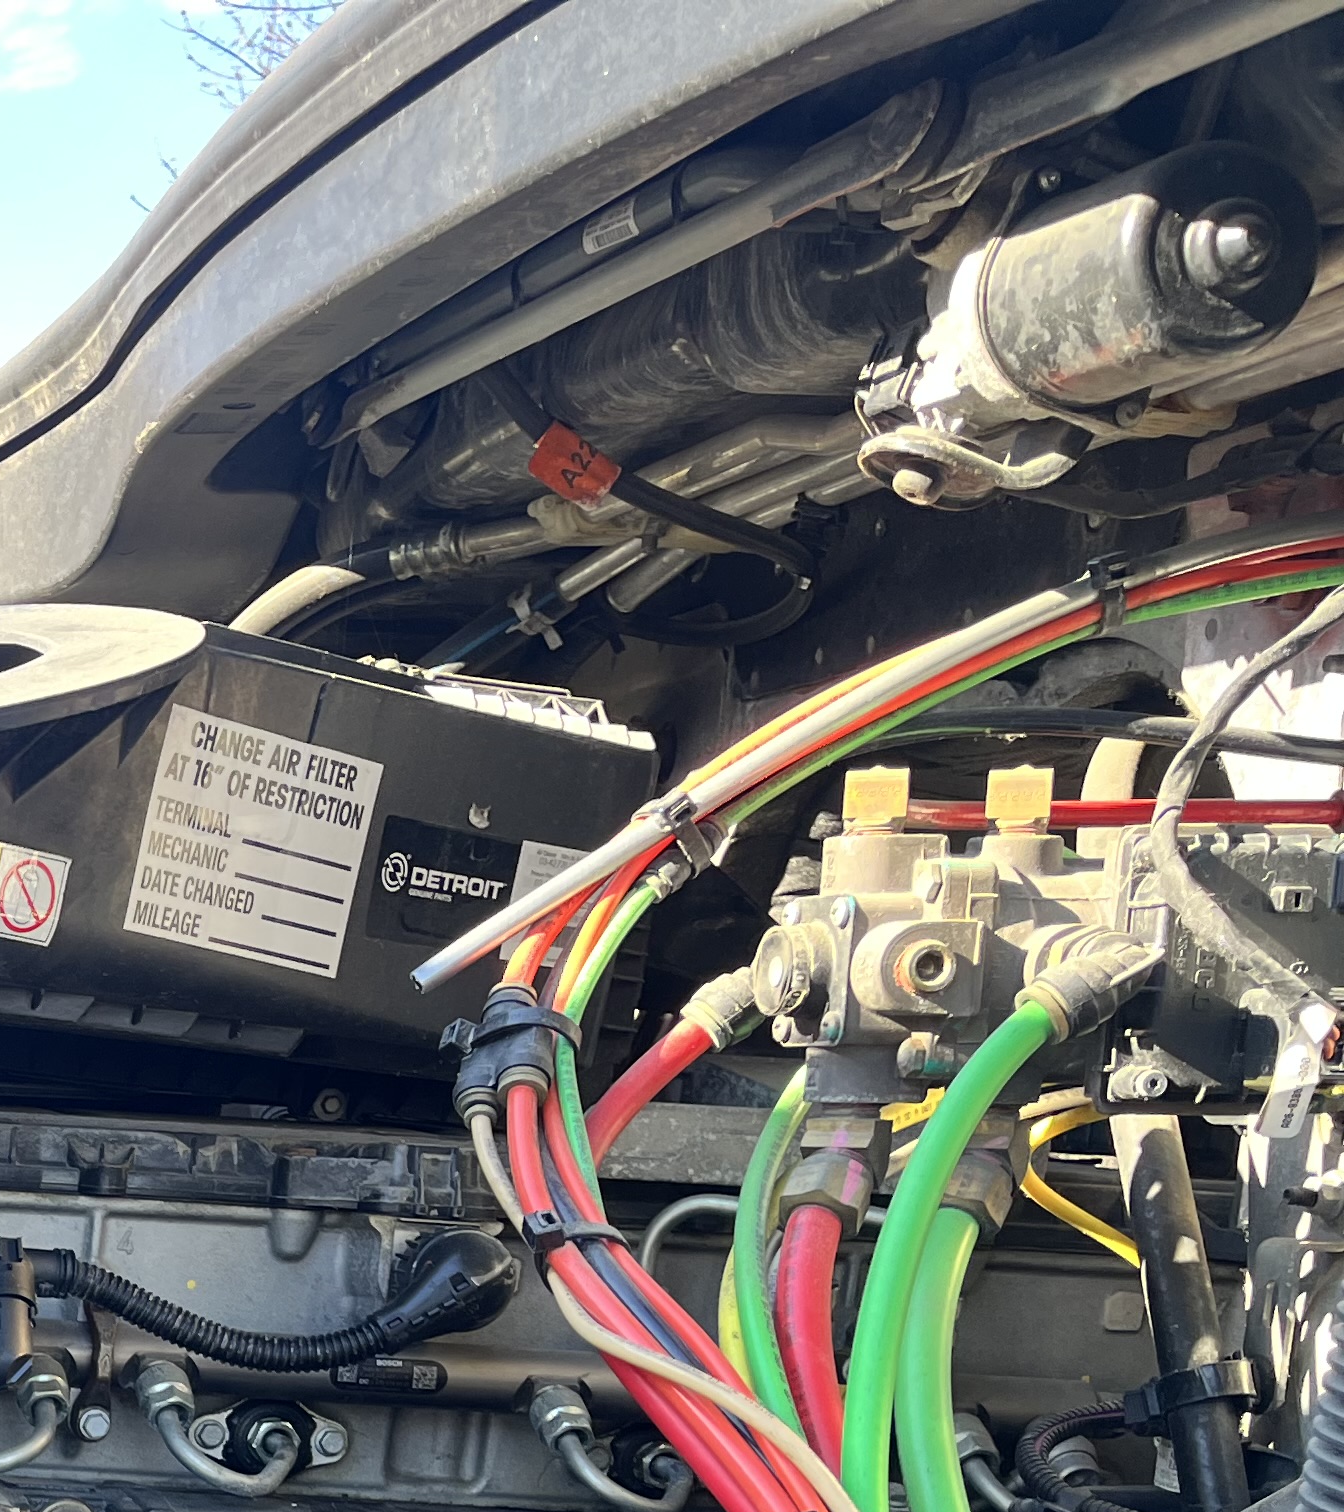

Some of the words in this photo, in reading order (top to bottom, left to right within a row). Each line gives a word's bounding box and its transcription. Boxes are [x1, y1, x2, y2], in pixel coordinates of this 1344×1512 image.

[191, 721, 266, 765] CHANGE
[268, 745, 301, 776] AIR
[306, 754, 357, 791] FILTER
[164, 753, 190, 782] AT
[227, 770, 252, 799] OF
[253, 777, 365, 830] RESTRICTION
[156, 795, 231, 838] TERMINAL
[147, 831, 229, 873] MECHANIC
[141, 866, 181, 897] DATE
[183, 876, 255, 915] CHANGED
[411, 866, 505, 900] DETROIT
[133, 900, 202, 938] MILEAGE
